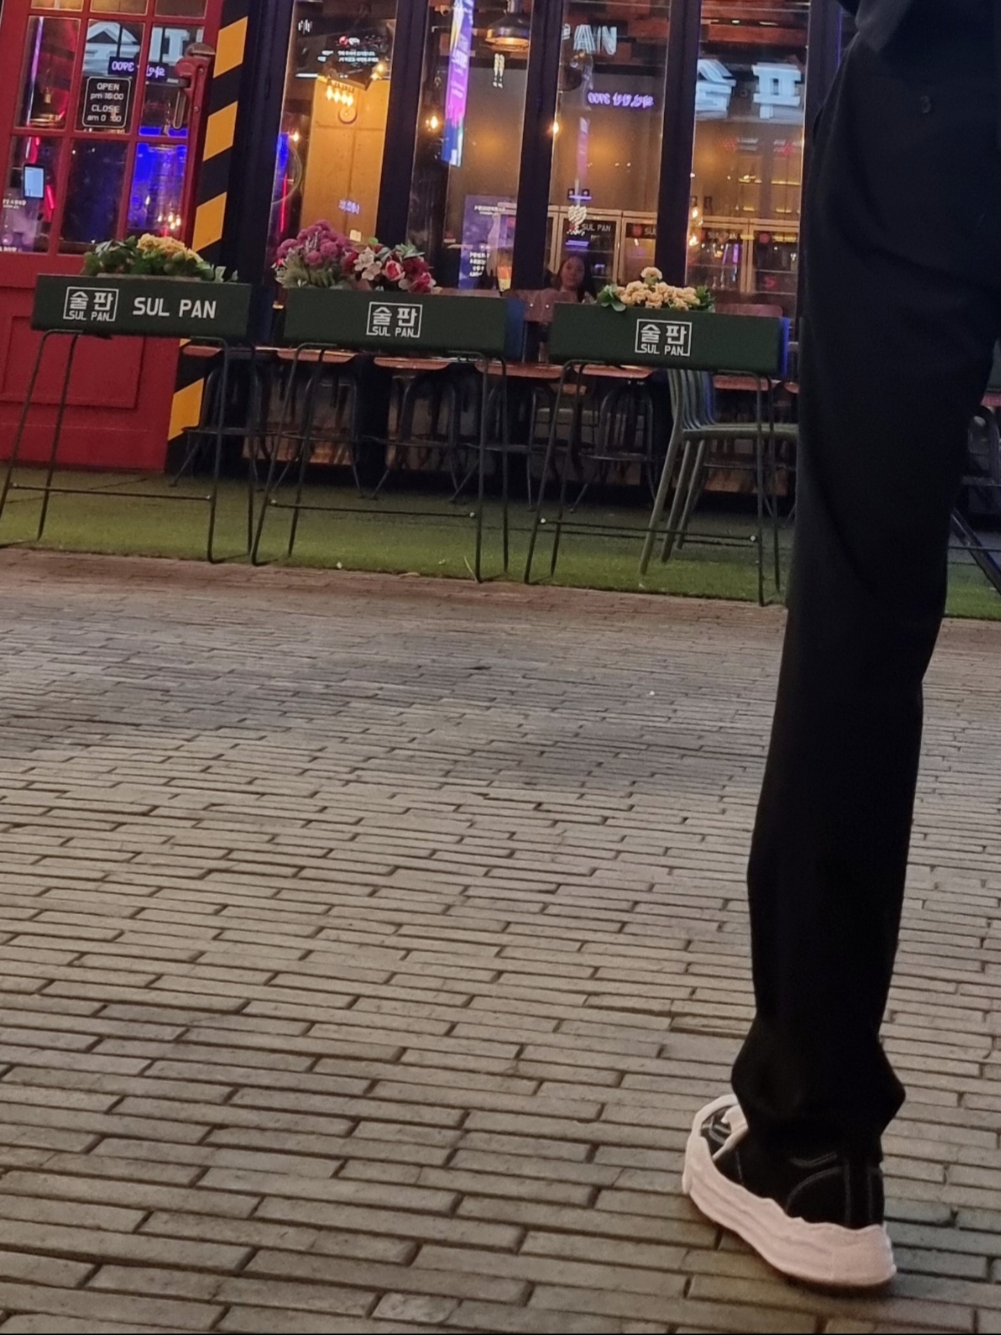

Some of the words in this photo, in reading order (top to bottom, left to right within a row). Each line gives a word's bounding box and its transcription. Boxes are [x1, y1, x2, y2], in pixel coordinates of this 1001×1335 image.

[96, 82, 120, 91] OPEN
[91, 104, 120, 113] CLOSE
[70, 291, 114, 311] 술판
[132, 297, 170, 316] SUL
[179, 299, 217, 319] PAN
[69, 310, 87, 321] SUL
[90, 311, 109, 322] PAN
[372, 306, 418, 327] 술판
[372, 326, 391, 337] SUL
[395, 327, 414, 338] PAN
[640, 324, 687, 345] 술판
[640, 343, 660, 354] SUL
[664, 345, 684, 356] PAN
